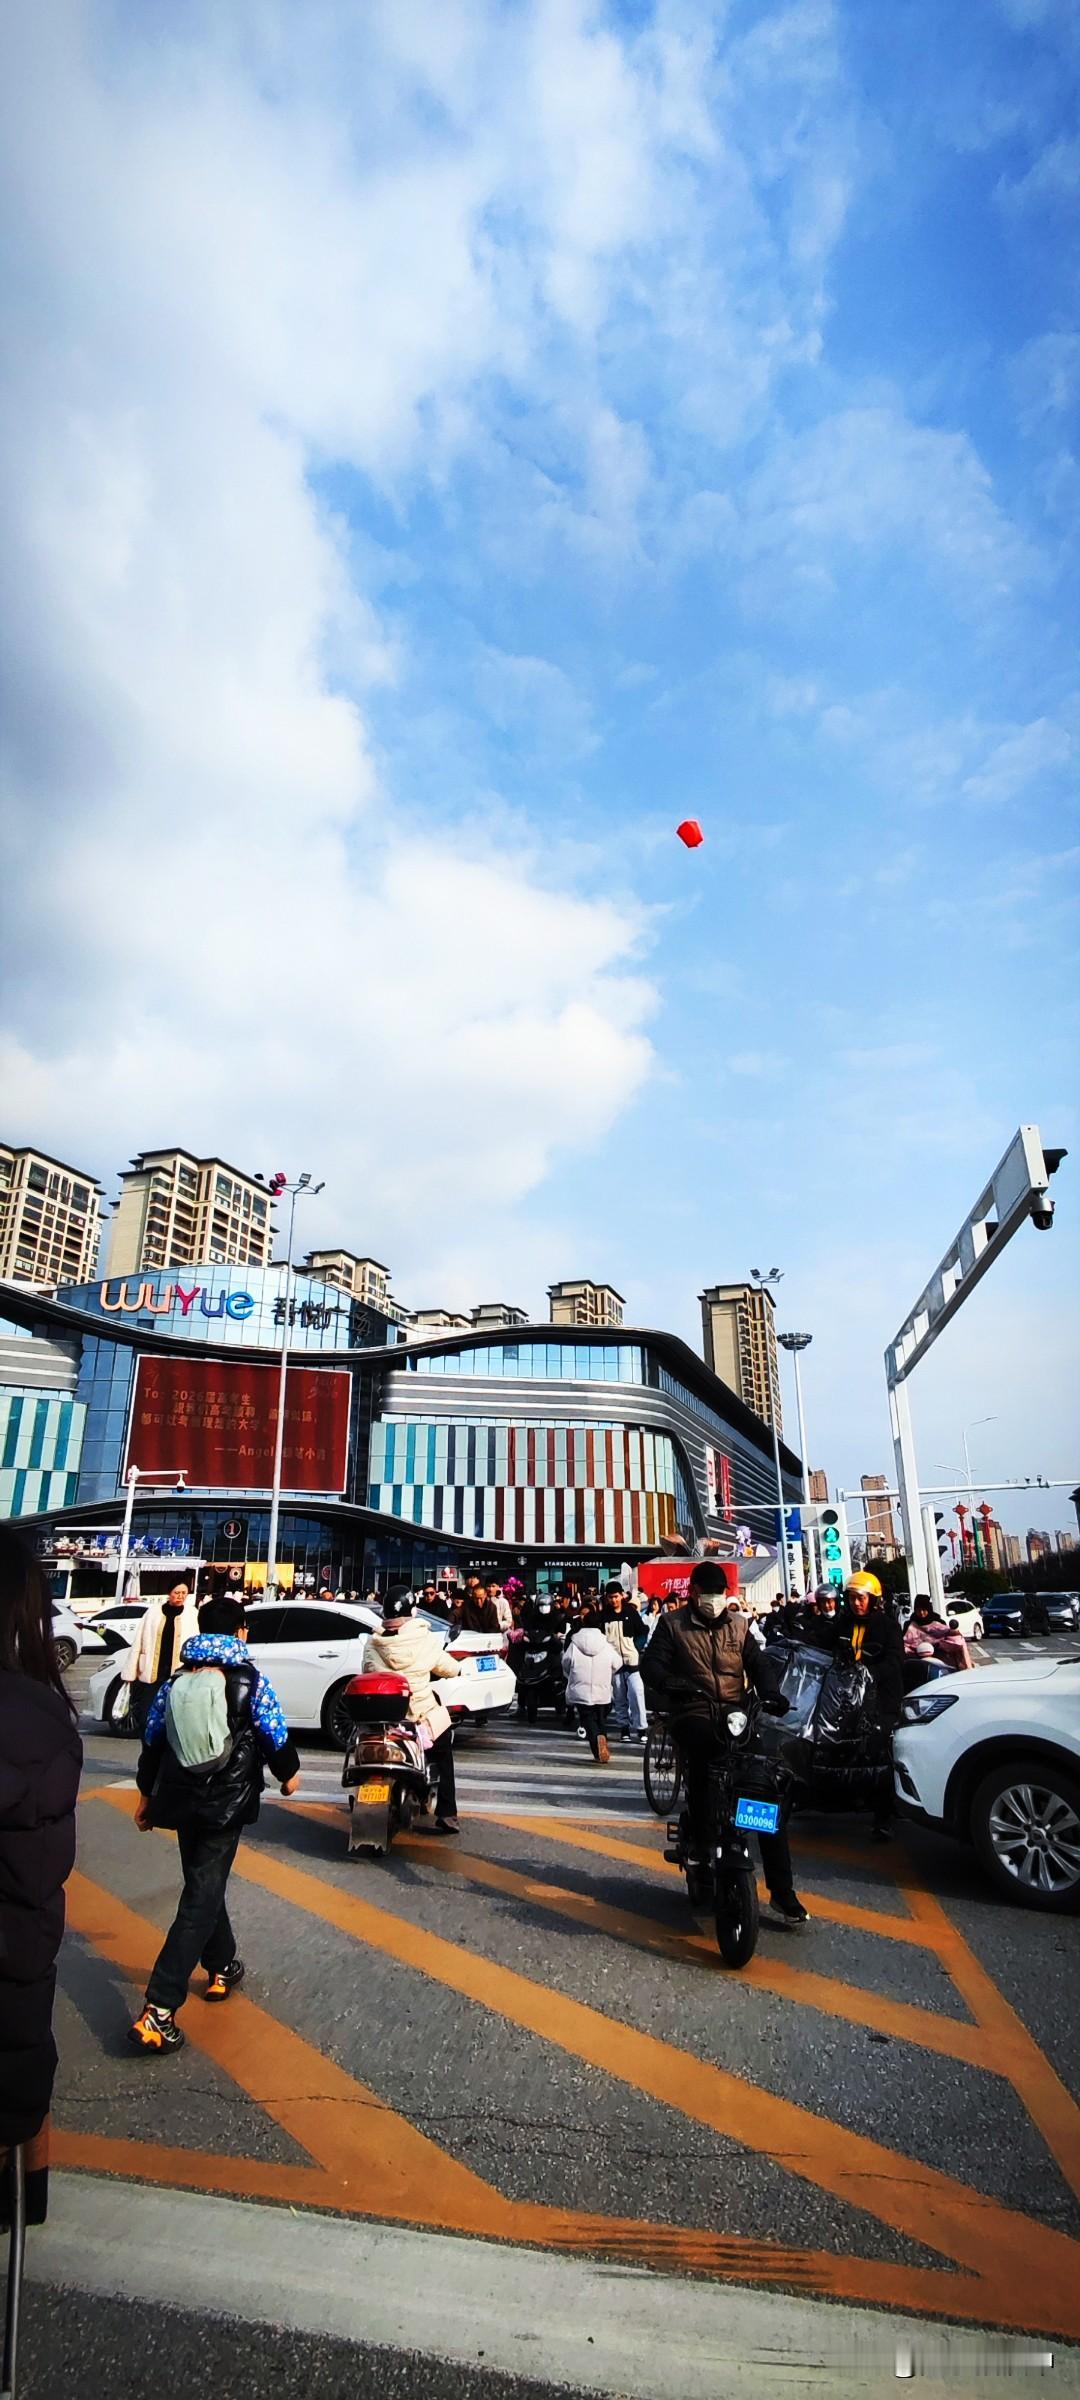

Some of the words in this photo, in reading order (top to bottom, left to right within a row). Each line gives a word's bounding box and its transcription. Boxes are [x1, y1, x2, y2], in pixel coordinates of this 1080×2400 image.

[271, 1296, 370, 1337] 吾悦广场
[738, 1813, 774, 1830] 0300096
